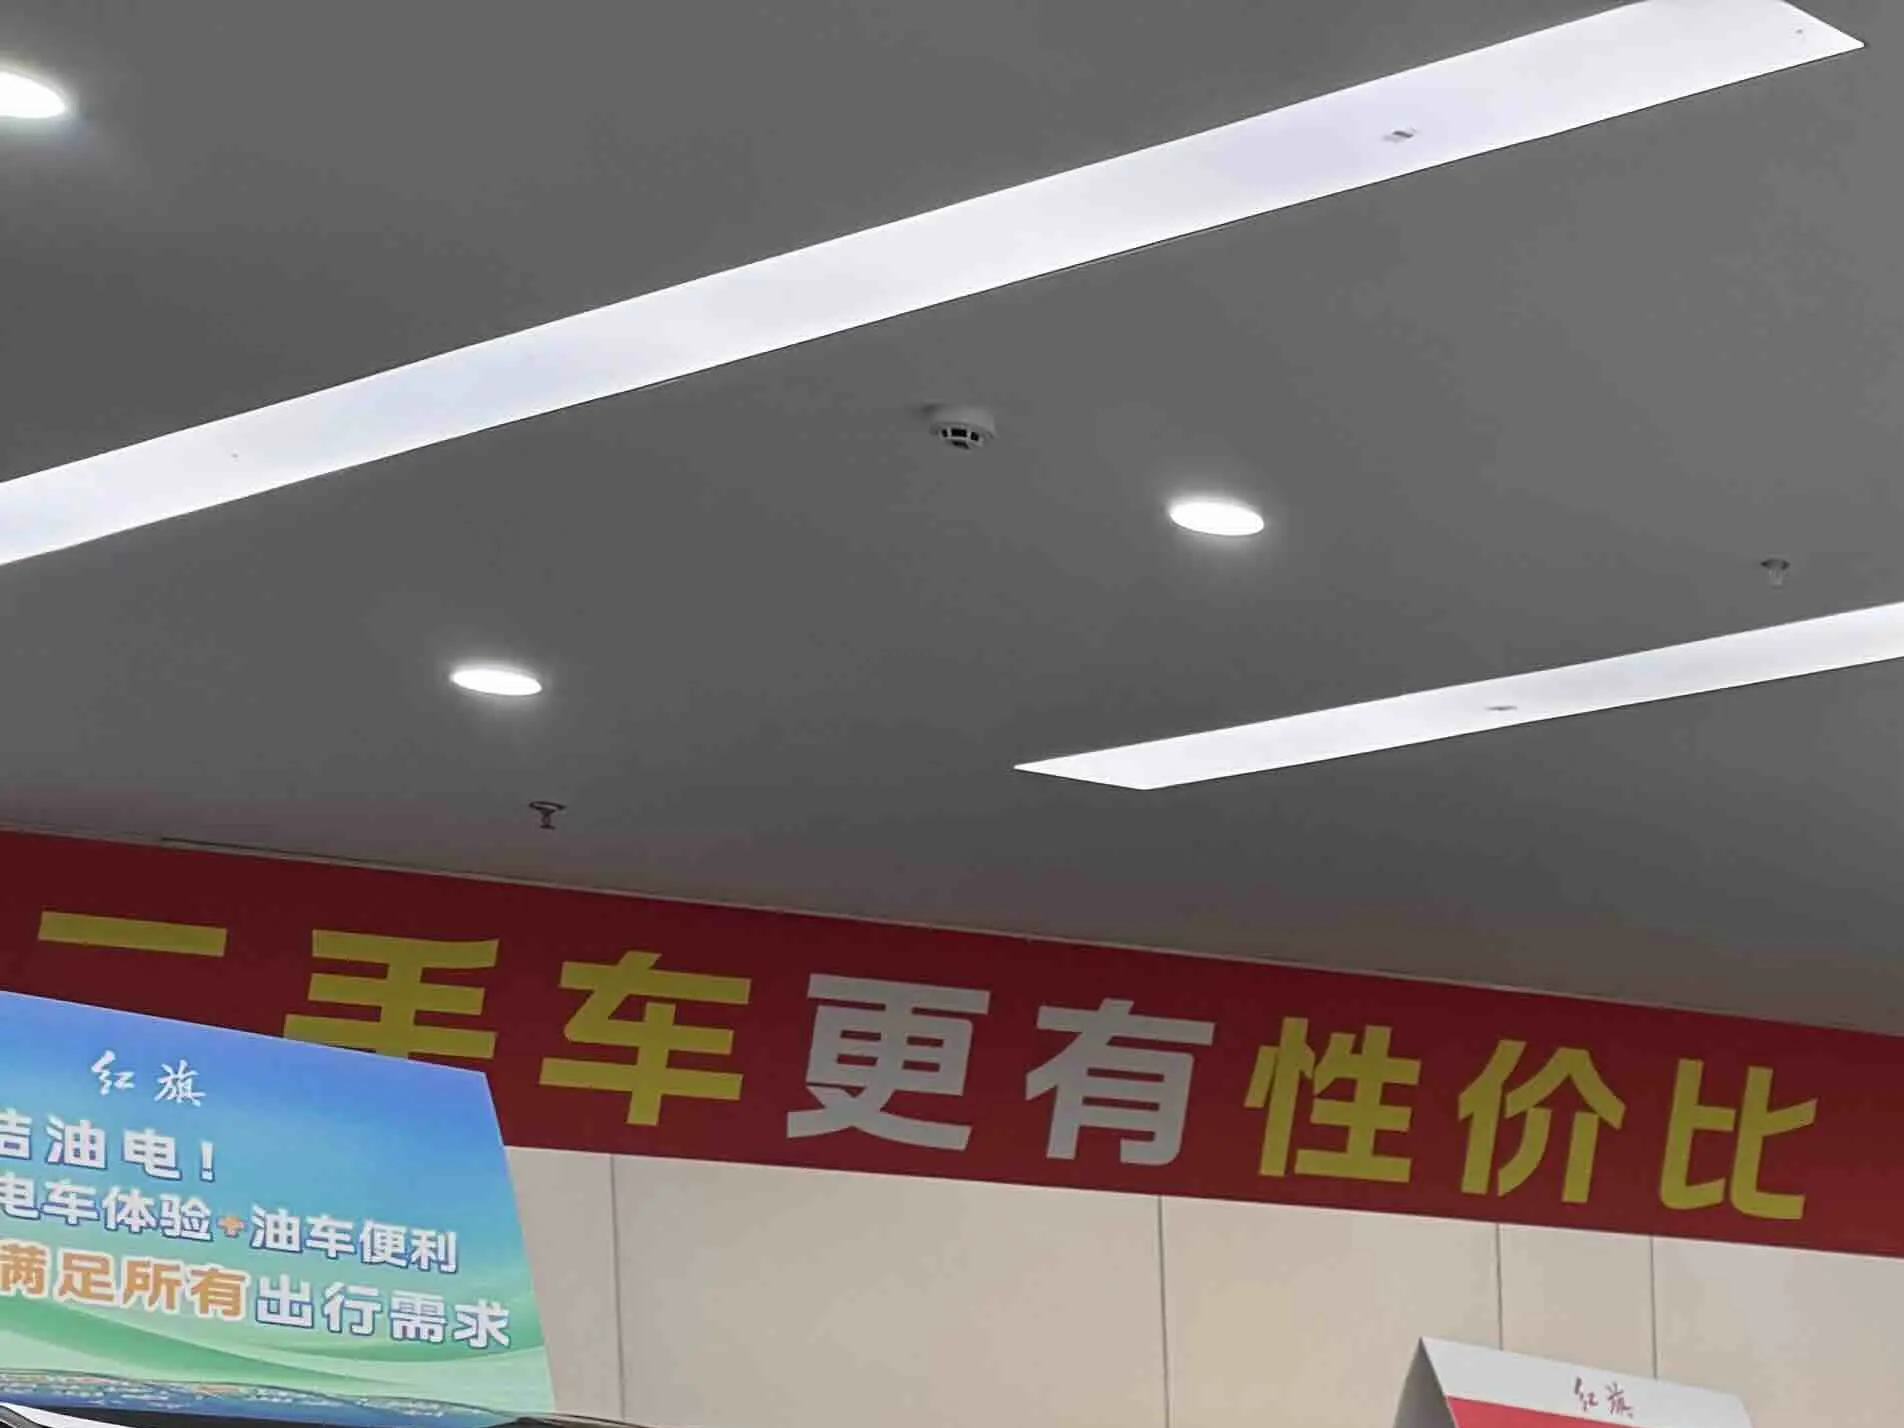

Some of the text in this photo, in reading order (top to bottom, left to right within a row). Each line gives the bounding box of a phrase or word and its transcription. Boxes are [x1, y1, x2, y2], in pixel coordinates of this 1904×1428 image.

[91, 1050, 206, 1107] 红旗
[0, 1238, 511, 1349] 满足所有出行需求
